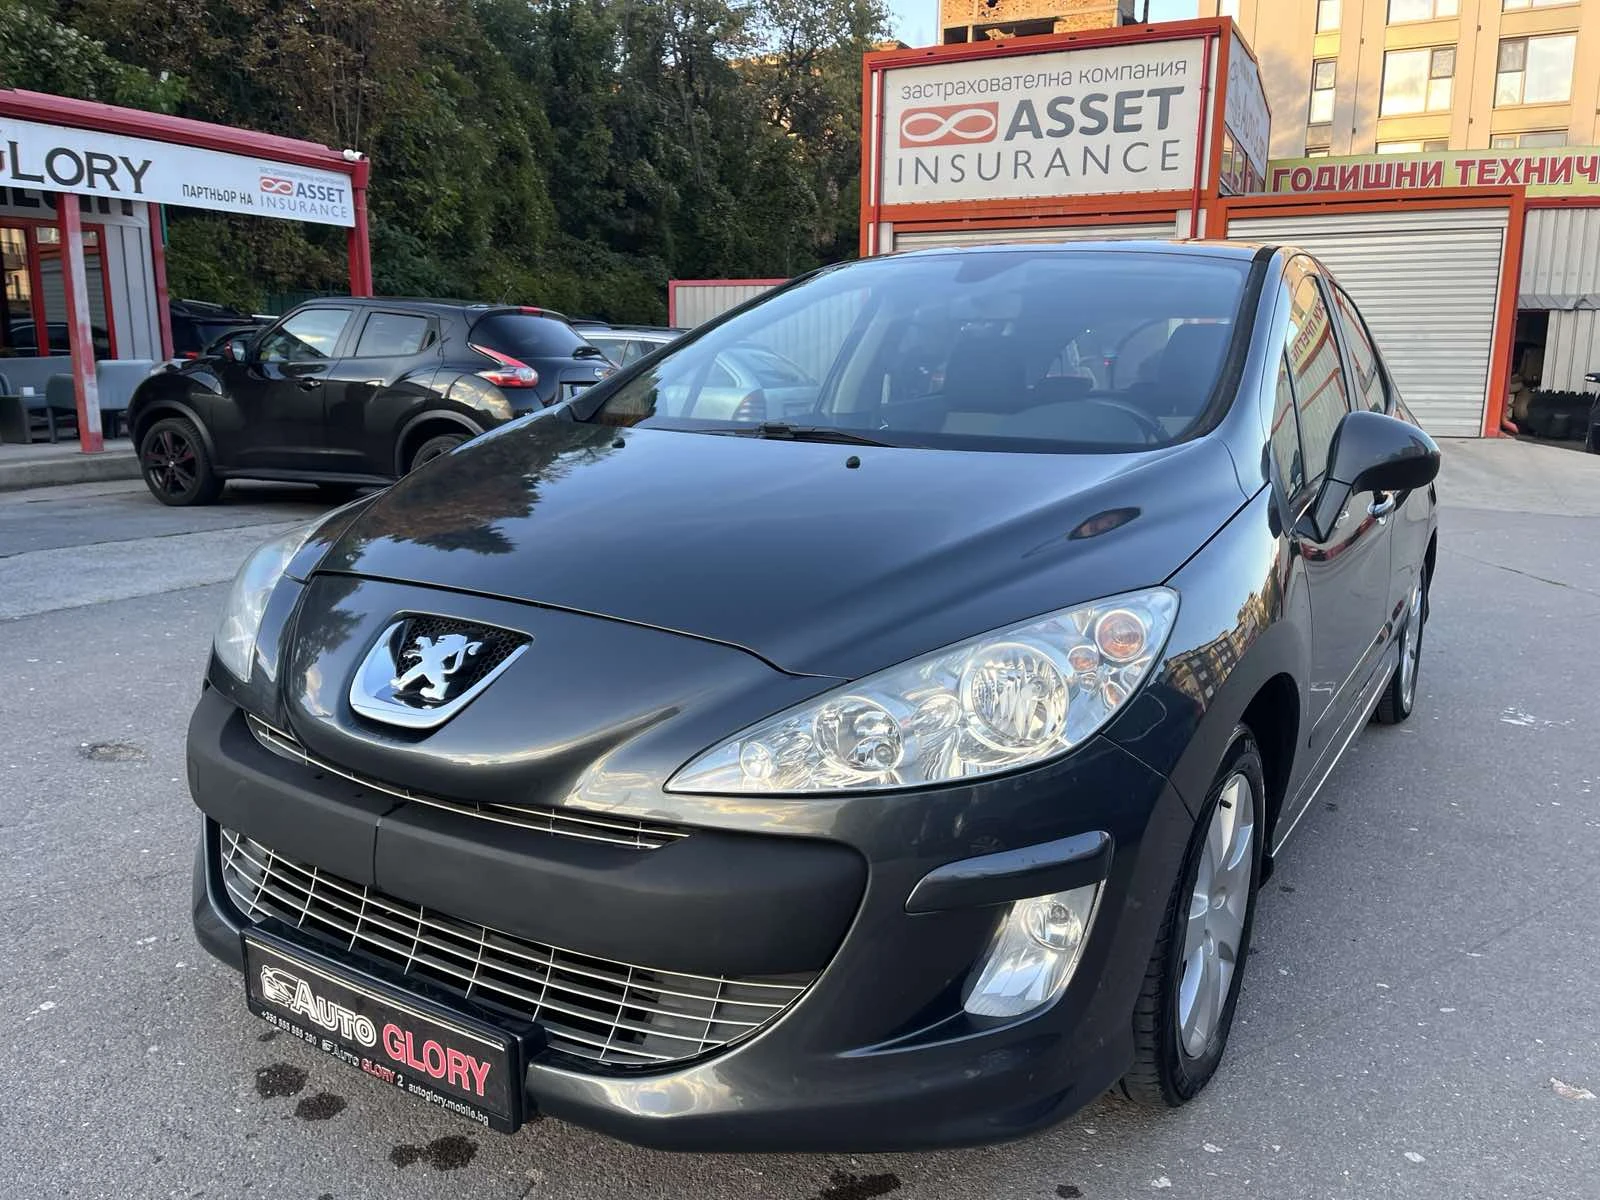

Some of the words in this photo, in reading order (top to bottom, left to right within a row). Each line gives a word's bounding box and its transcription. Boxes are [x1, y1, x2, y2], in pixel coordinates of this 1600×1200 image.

[902, 70, 1072, 102] застрахователна
[1079, 59, 1187, 86] компания
[1004, 86, 1185, 141] ASSET
[0, 140, 152, 194] LORY
[897, 139, 1181, 187] INSURANCE
[1272, 160, 1445, 193] ГОДИШНИ
[182, 183, 237, 205] ПАРТНЬОР
[240, 192, 254, 206] НА
[260, 195, 348, 218] INSURANCE
[296, 182, 345, 204] ASSET
[360, 1058, 396, 1084] GLORY
[397, 1075, 405, 1087] 2
[382, 1023, 491, 1096] GLORY
[408, 1082, 489, 1127] autoglory.mobile.bg
